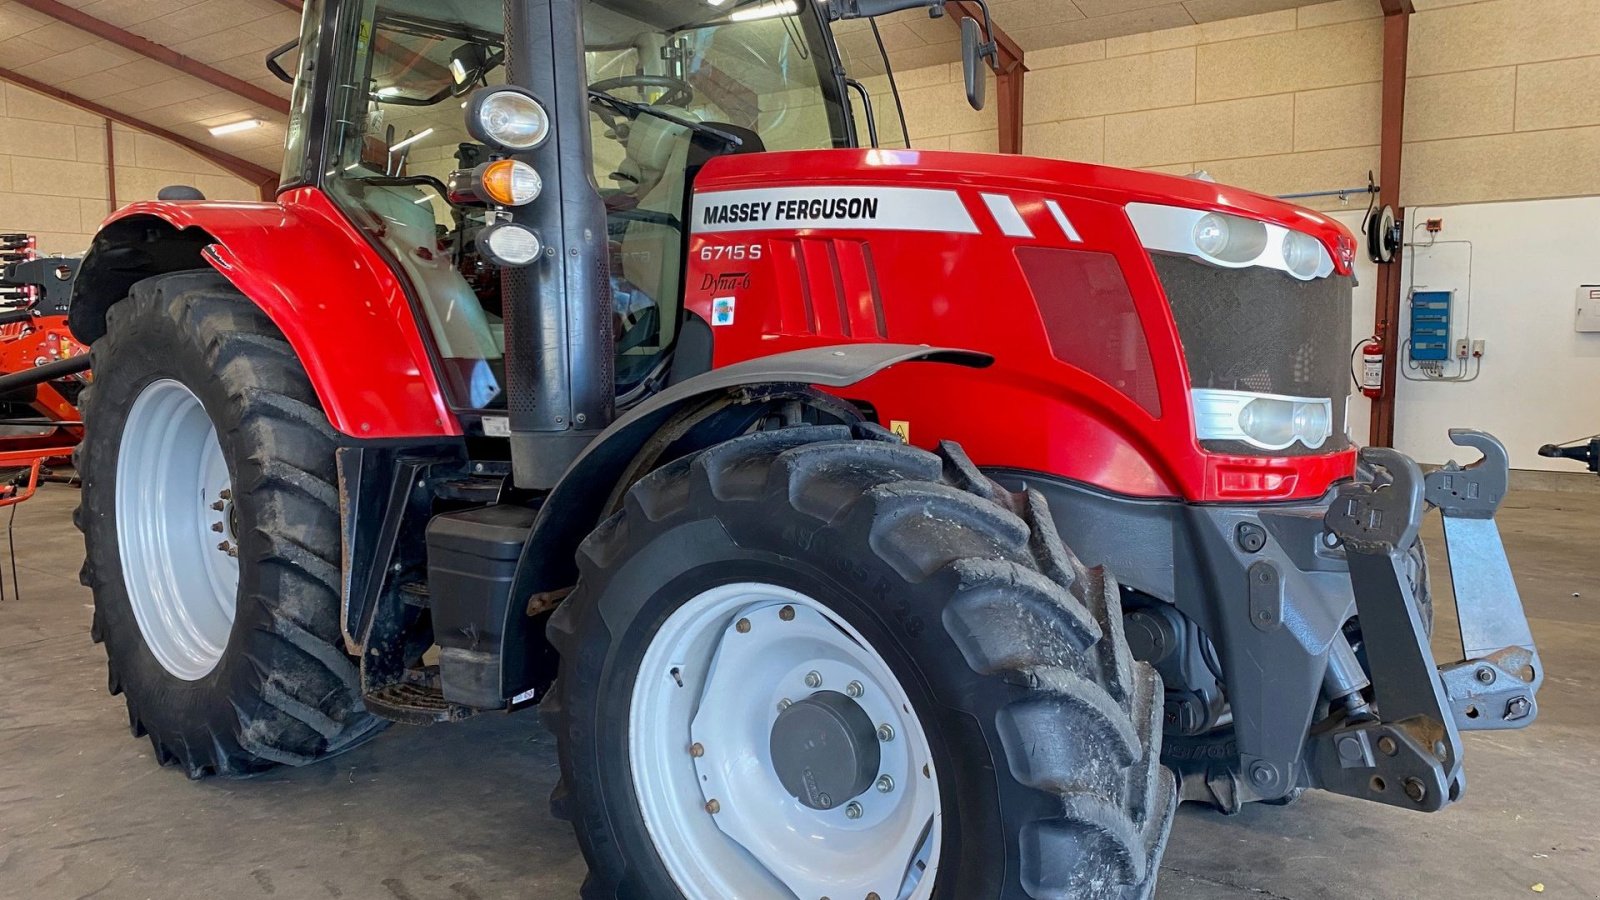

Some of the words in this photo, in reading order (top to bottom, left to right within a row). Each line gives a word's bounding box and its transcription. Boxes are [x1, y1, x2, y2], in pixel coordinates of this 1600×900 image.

[703, 202, 771, 224] MASSEY
[775, 198, 878, 220] FERGUSON
[701, 246, 745, 260] 6715
[749, 244, 762, 259] S
[701, 272, 750, 296] Dyna-6
